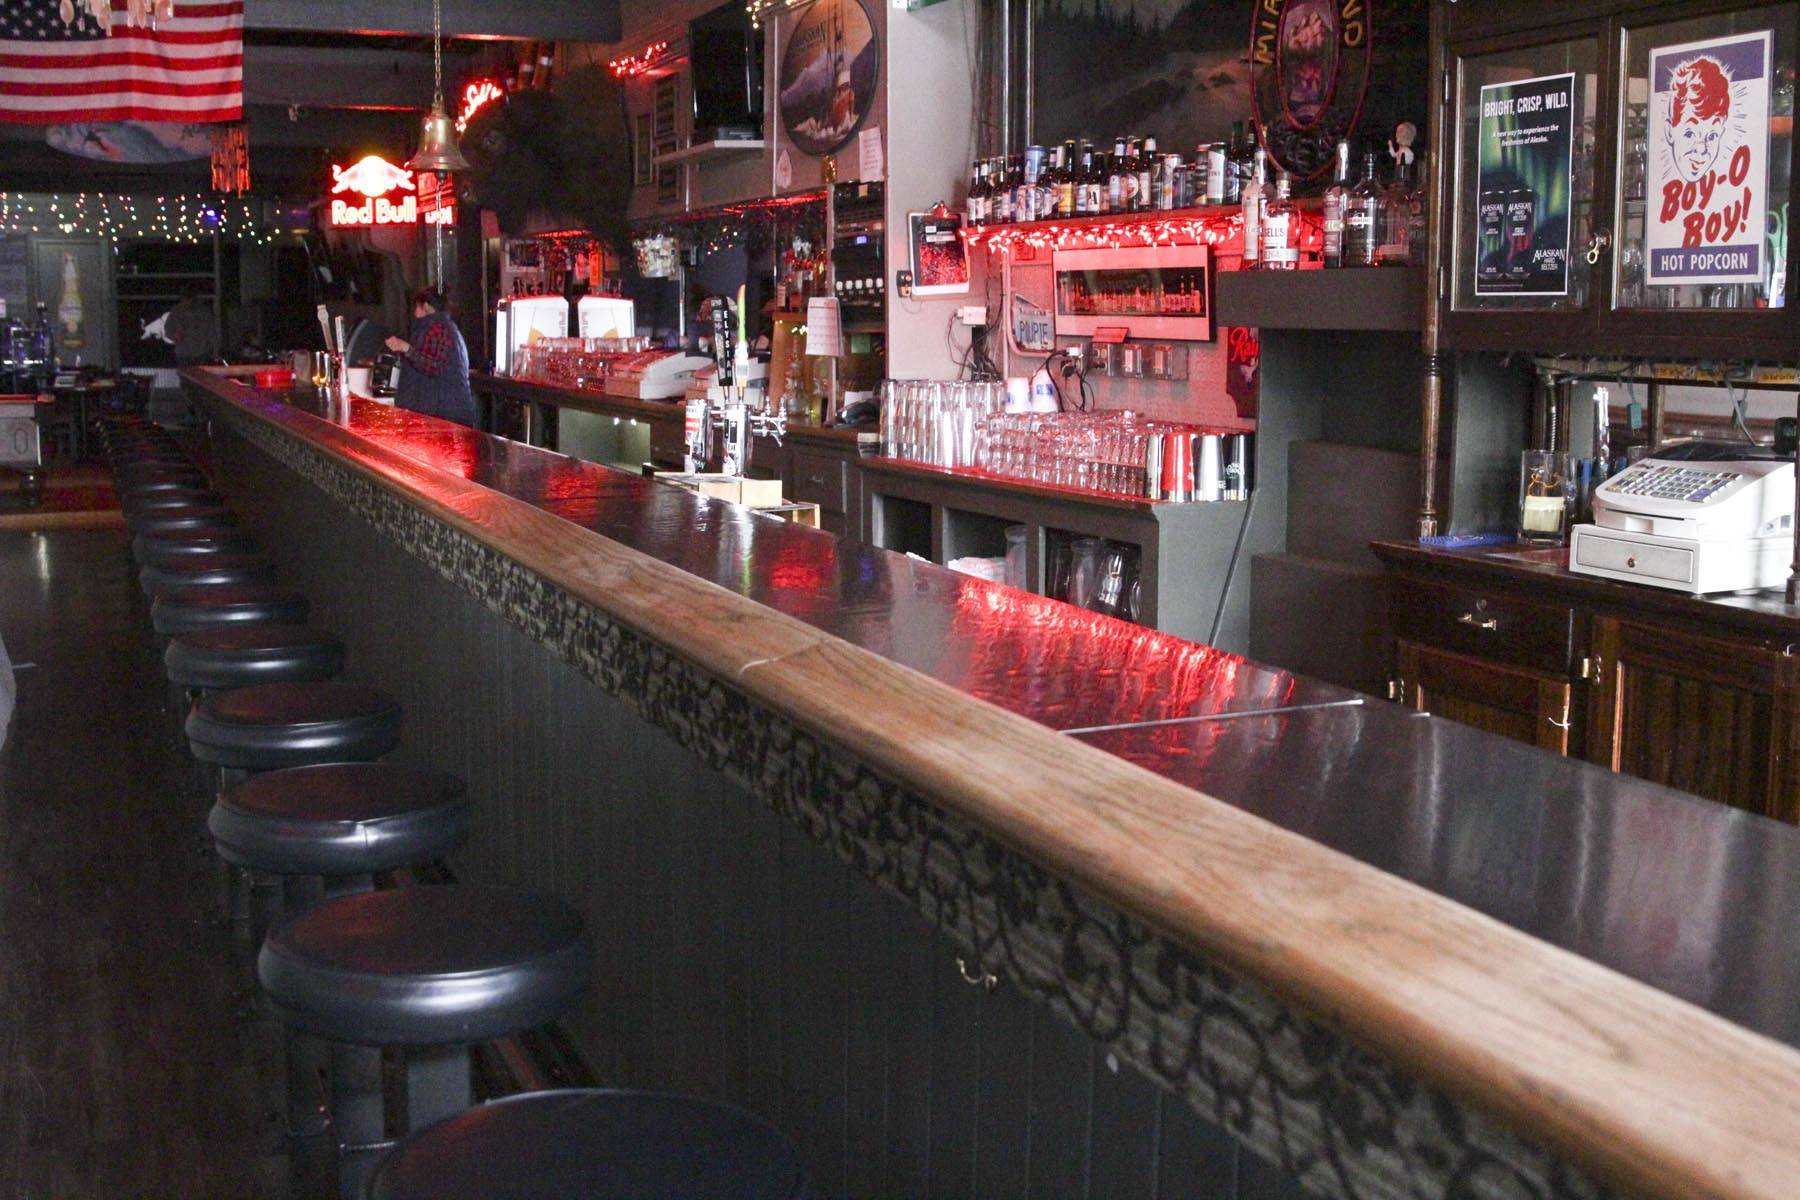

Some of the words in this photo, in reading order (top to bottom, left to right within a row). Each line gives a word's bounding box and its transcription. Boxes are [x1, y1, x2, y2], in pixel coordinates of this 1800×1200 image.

[1484, 98, 1515, 118] BRIGHT,
[1517, 95, 1543, 113] CRISP,
[1545, 91, 1569, 110] WILD.
[1523, 126, 1550, 135] experience
[1550, 124, 1559, 132] the
[332, 197, 373, 224] Red
[375, 195, 417, 224] Bull
[1480, 203, 1504, 217] ALASKAN
[1507, 202, 1532, 215] ALASKAN
[1532, 249, 1566, 263] ALASKAN
[1661, 254, 1684, 271] HOT
[1690, 252, 1749, 271] POPCORN
[723, 310, 732, 379] ELYSIAN
